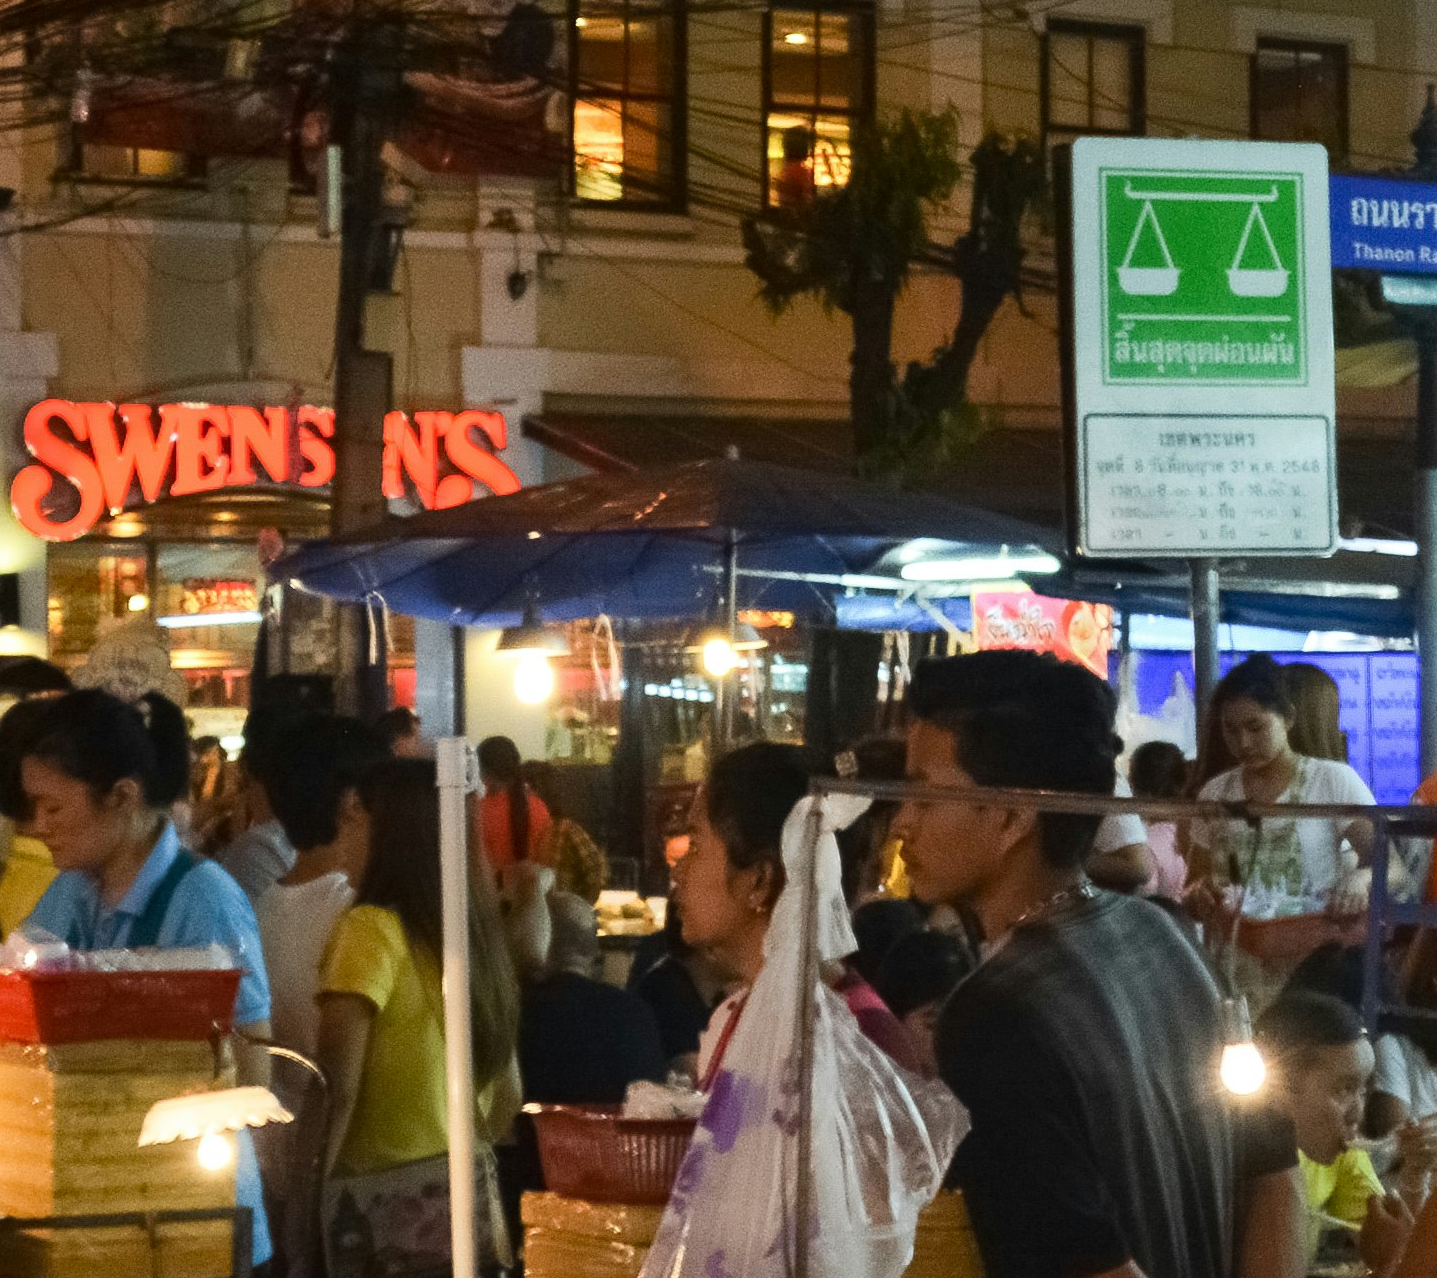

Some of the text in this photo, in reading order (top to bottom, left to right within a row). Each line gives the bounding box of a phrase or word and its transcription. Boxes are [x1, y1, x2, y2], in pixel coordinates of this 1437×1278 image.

[1353, 242, 1416, 262] Thanon
[1115, 320, 1296, 374] สิ้นสุดจุดผ่อนผัน
[11, 398, 522, 542] SWENSN'S
